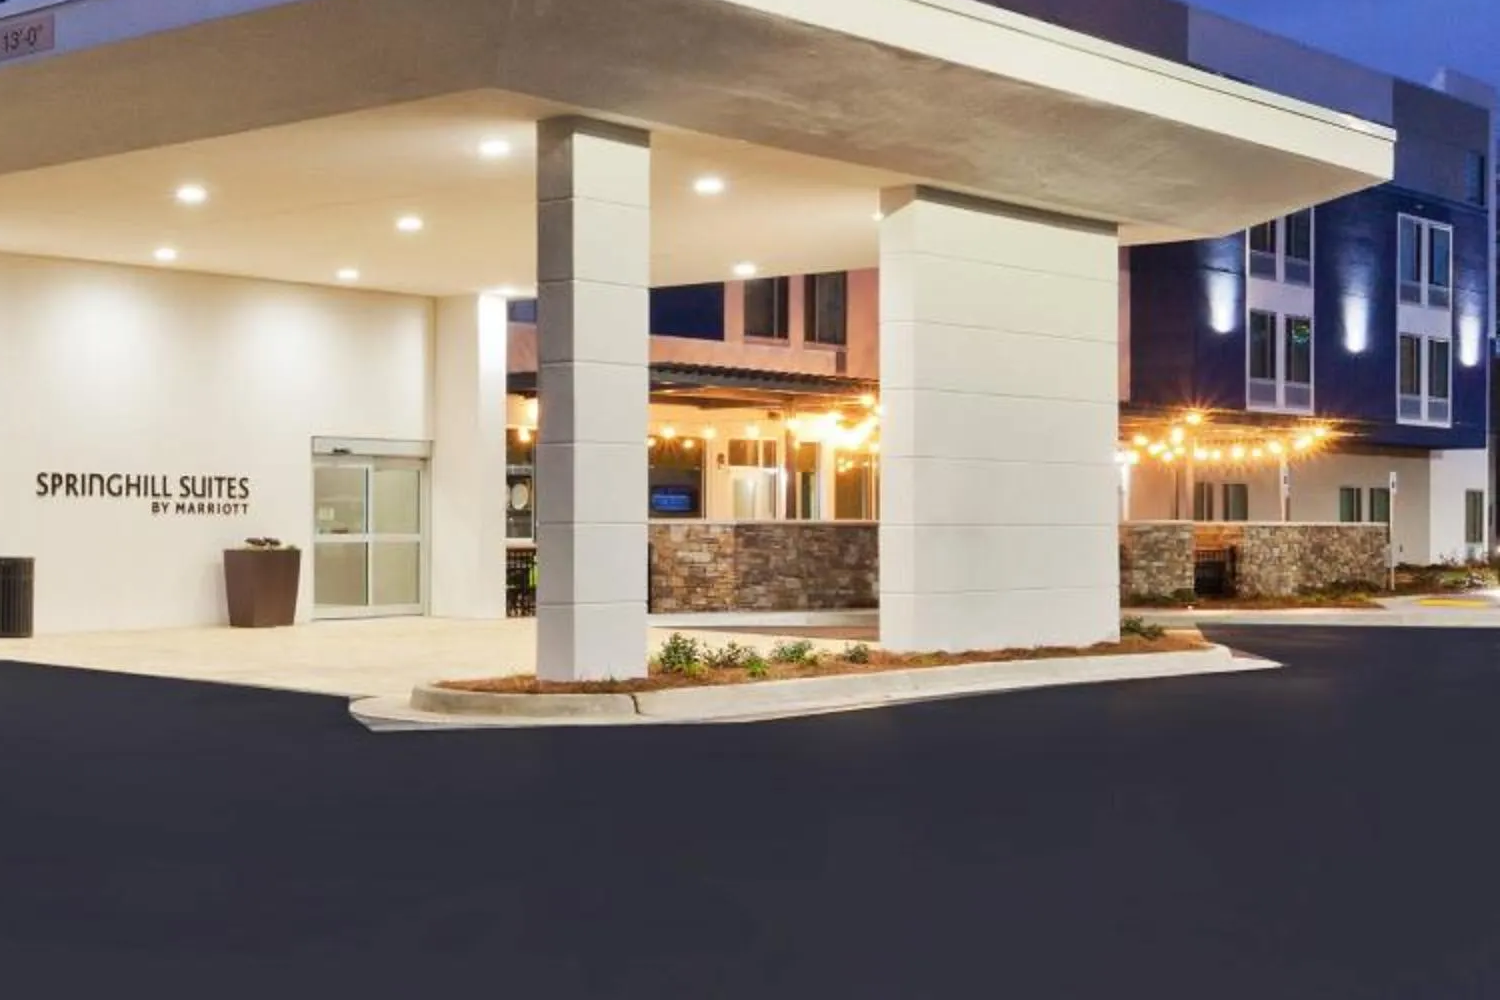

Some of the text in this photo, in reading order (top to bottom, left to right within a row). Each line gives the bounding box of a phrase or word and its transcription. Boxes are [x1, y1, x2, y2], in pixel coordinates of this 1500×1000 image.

[36, 472, 250, 499] SPRINGHILL SUITES
[151, 501, 250, 515] BY MARRIOTT
